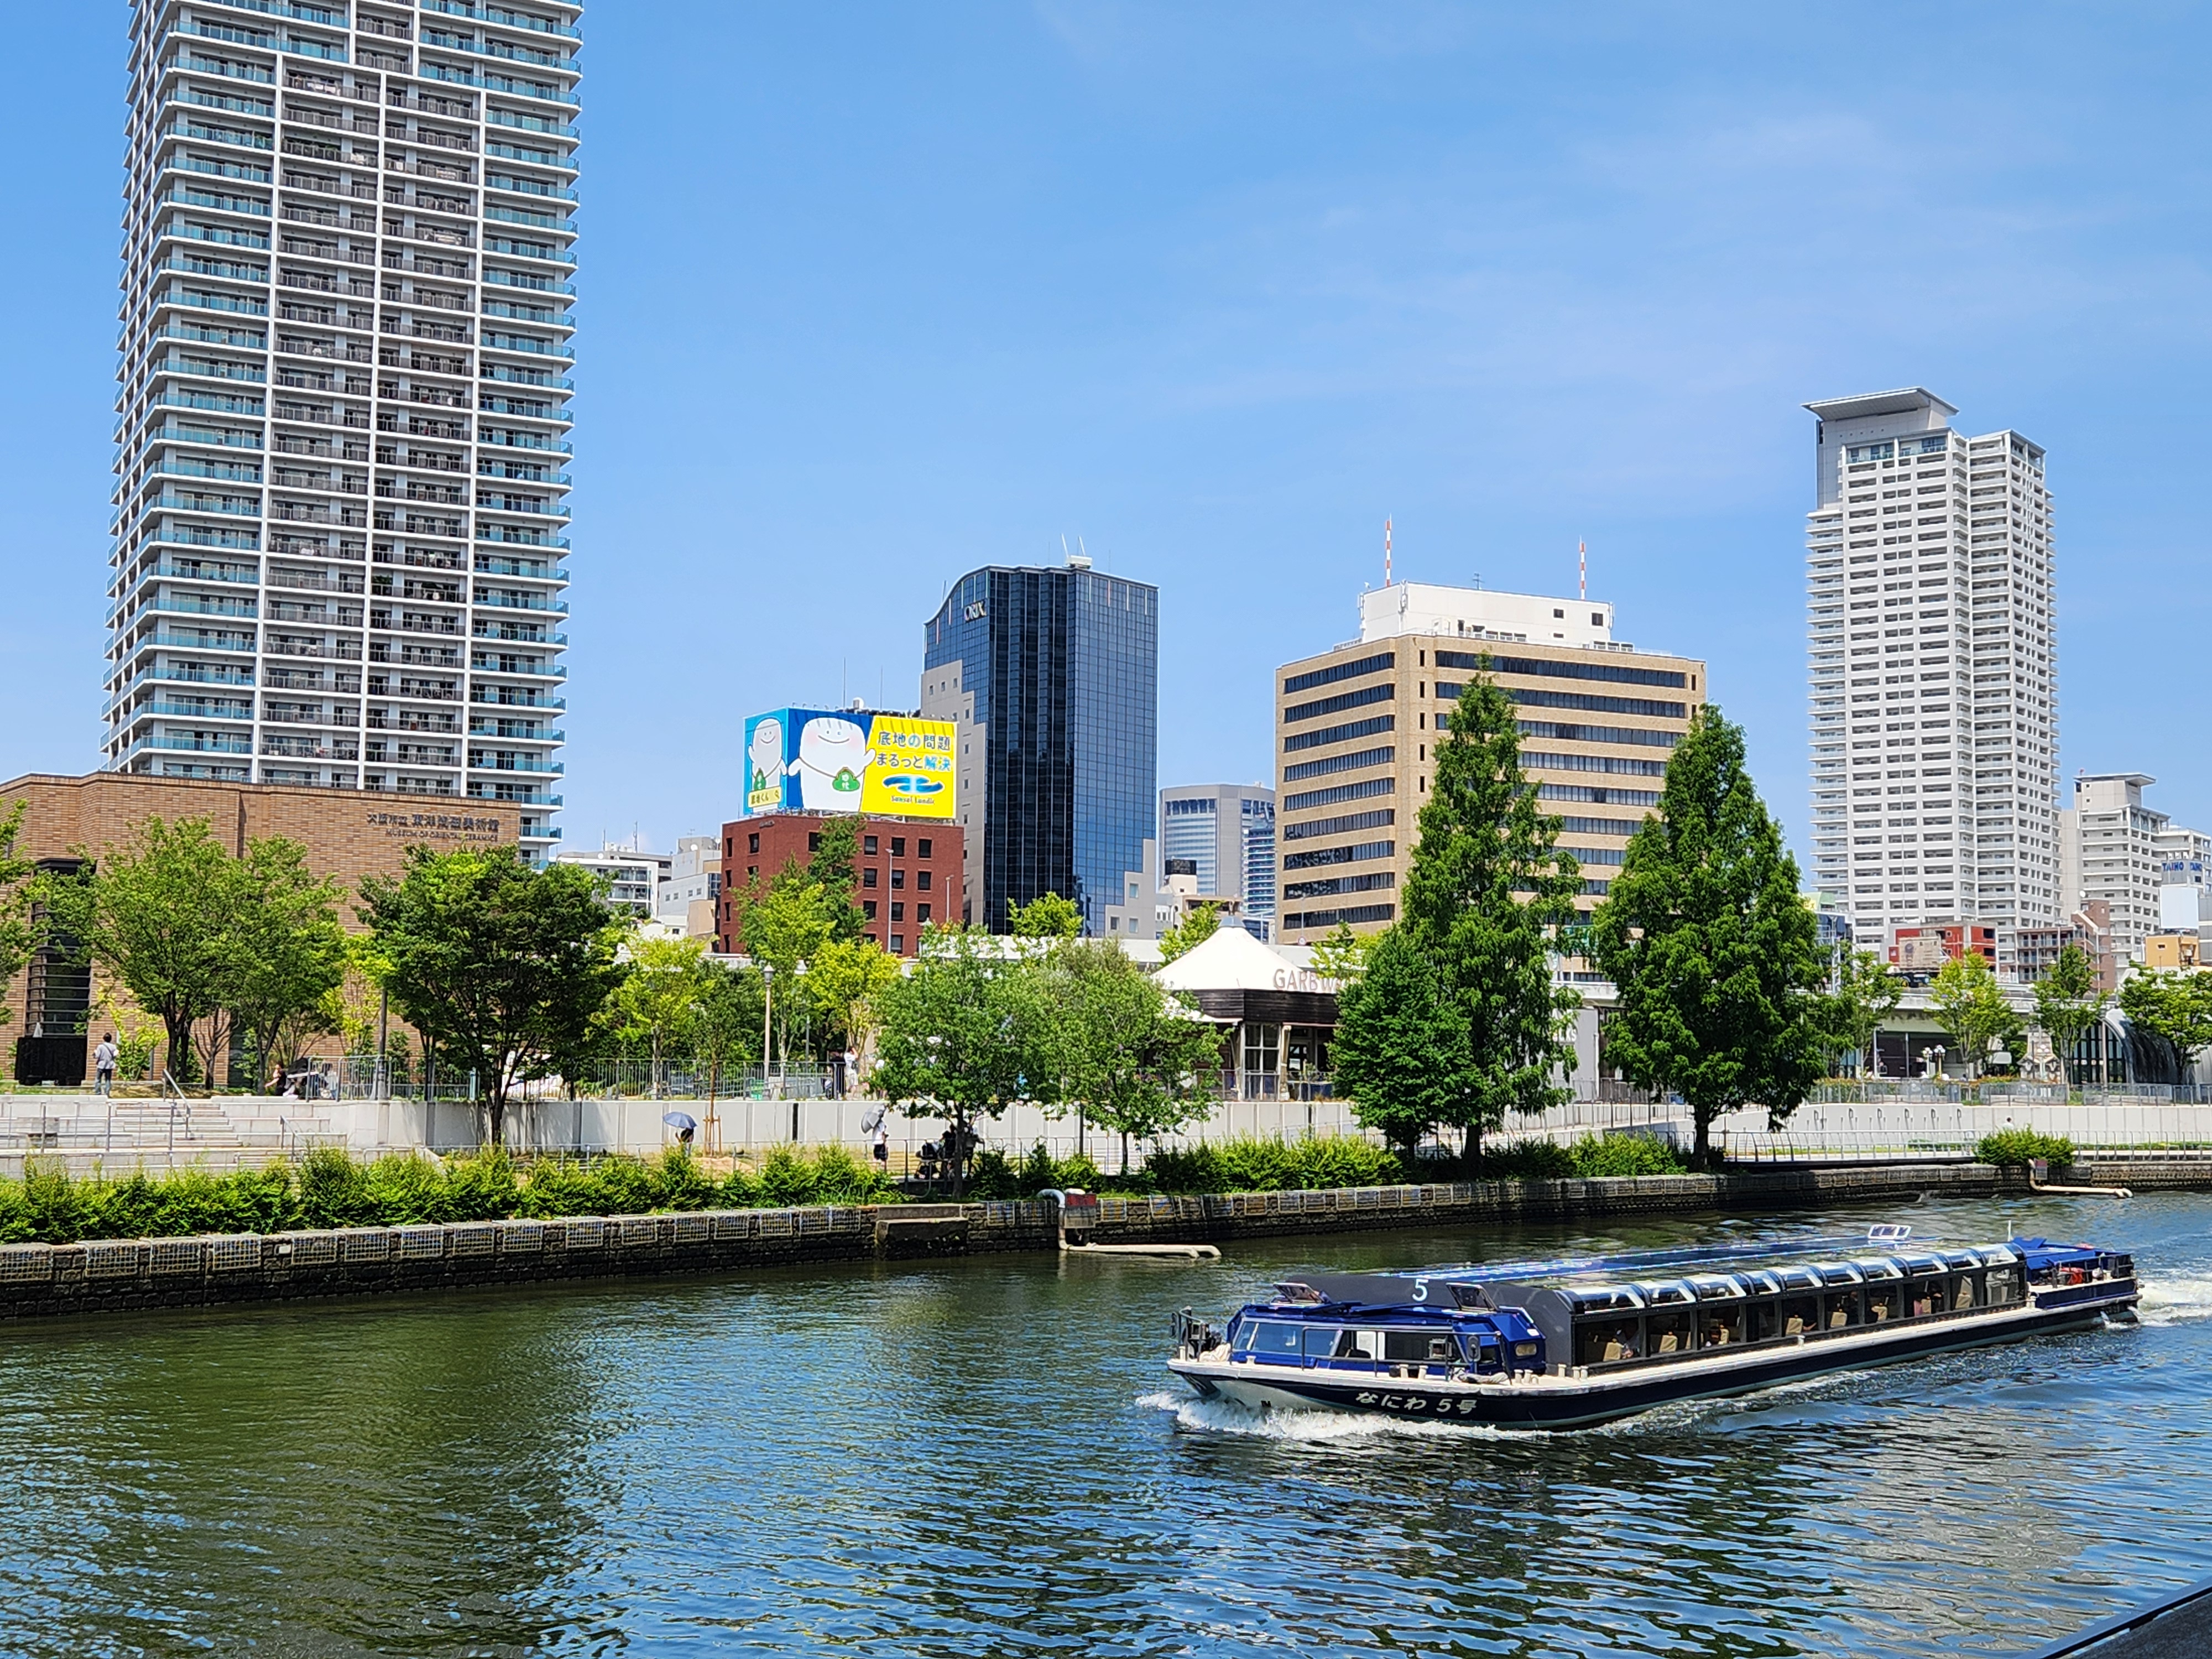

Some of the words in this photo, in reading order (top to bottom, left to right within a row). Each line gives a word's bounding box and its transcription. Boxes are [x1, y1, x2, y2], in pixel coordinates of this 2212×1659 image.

[964, 601, 987, 622] ORIX
[878, 731, 951, 751] 底地の問題
[877, 752, 951, 771] まるっと解決
[1273, 968, 1318, 991] GARB
[1412, 1279, 1429, 1301] 5
